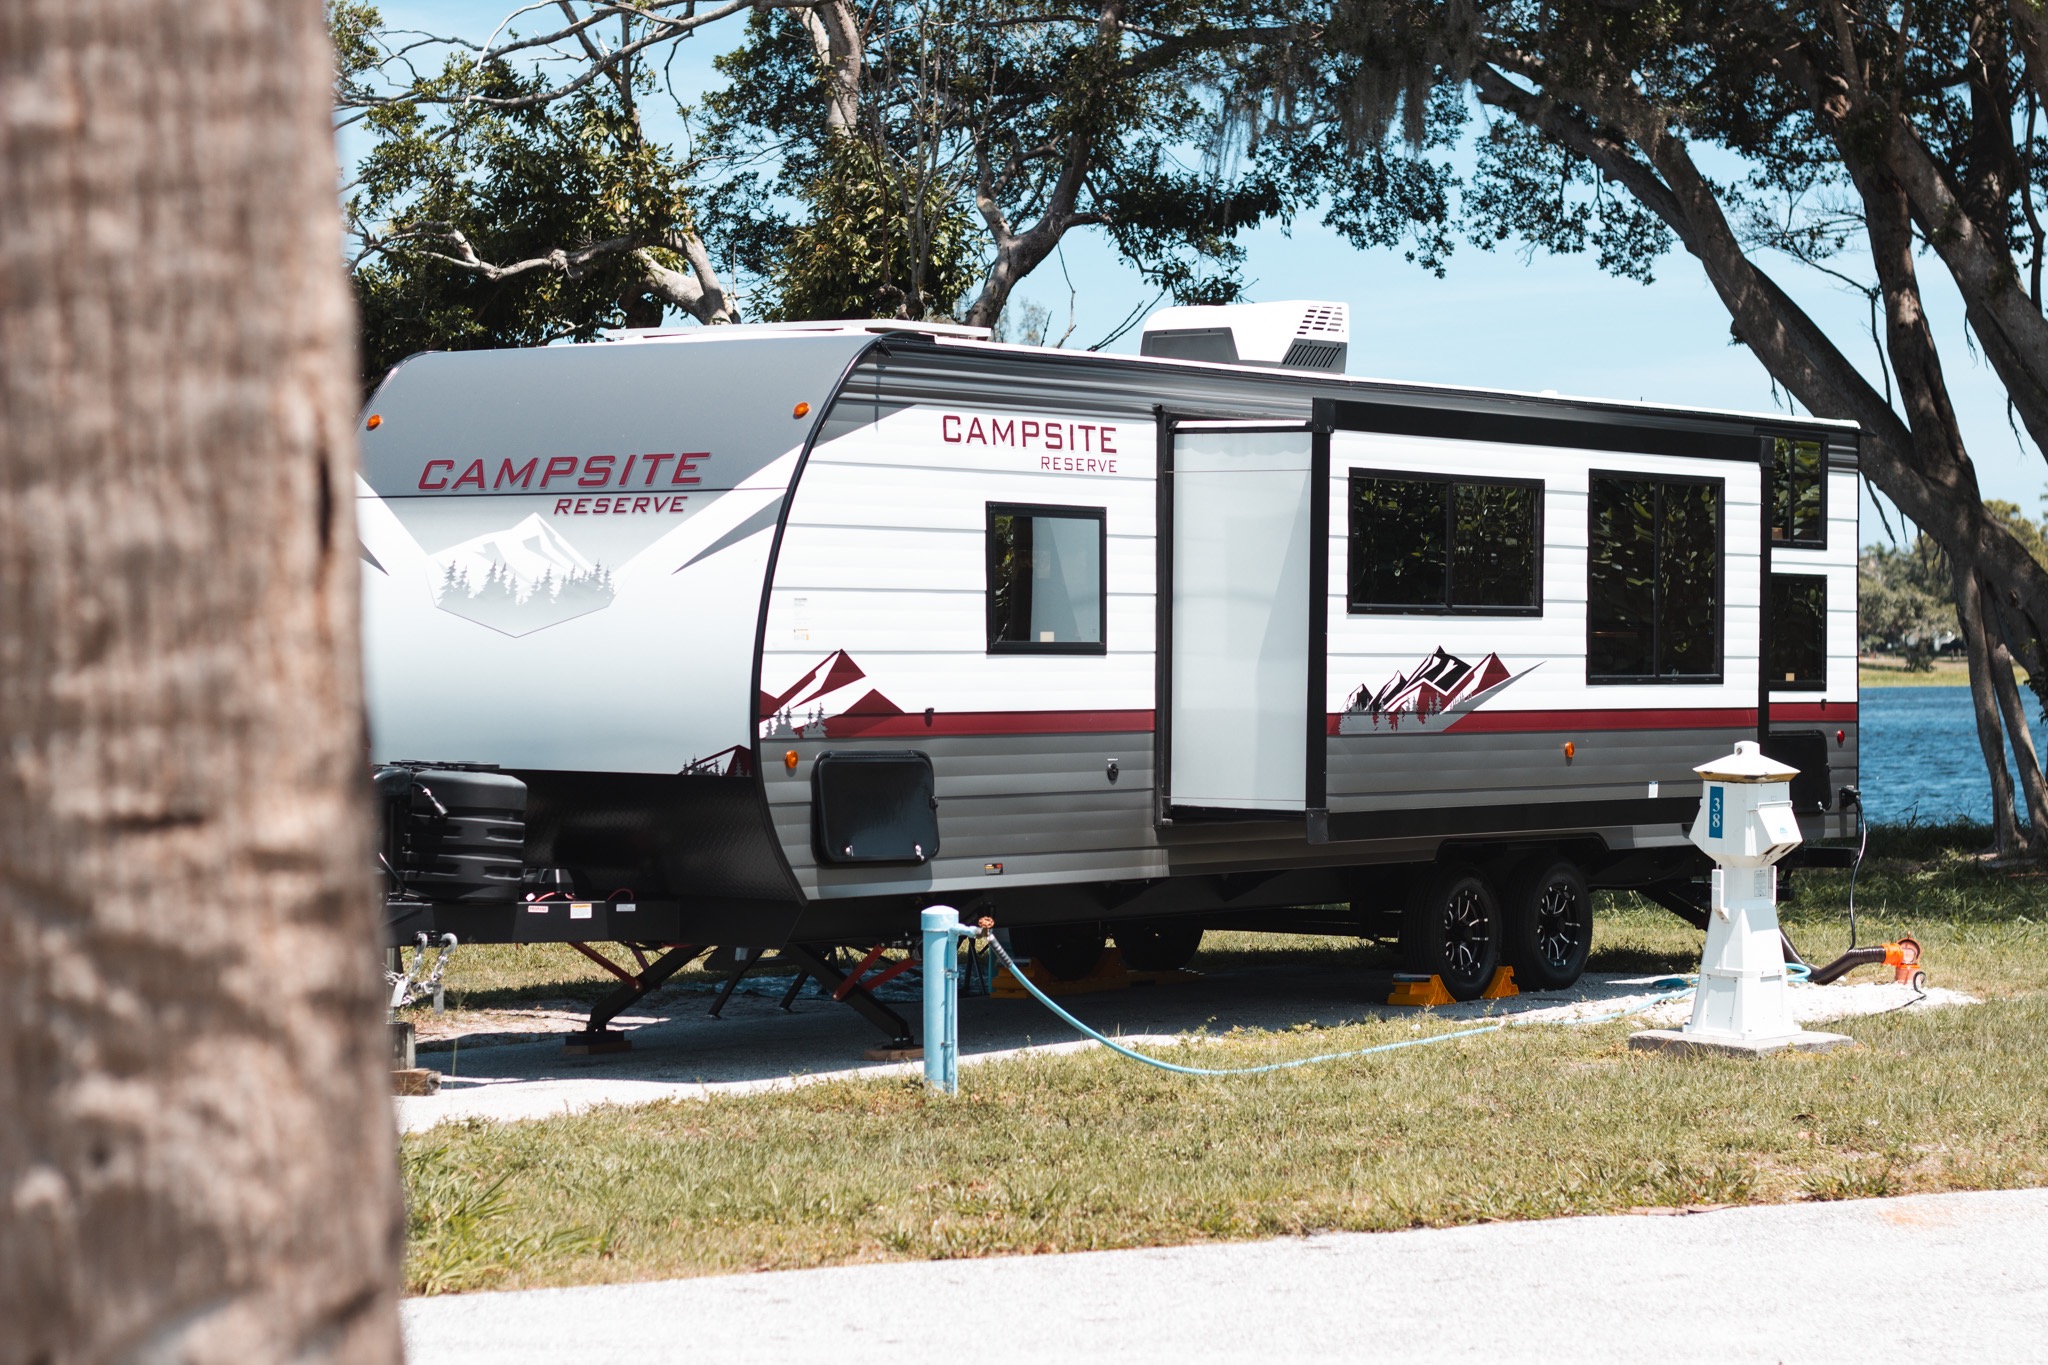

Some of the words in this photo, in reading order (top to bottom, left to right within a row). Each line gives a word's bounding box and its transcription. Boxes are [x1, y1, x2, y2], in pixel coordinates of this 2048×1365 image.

[943, 415, 1117, 453] CAMPSITE
[418, 452, 711, 490] CAMPSITE
[1041, 456, 1117, 473] RESERVE
[554, 496, 688, 514] RESERVE
[1712, 797, 1720, 828] 38
